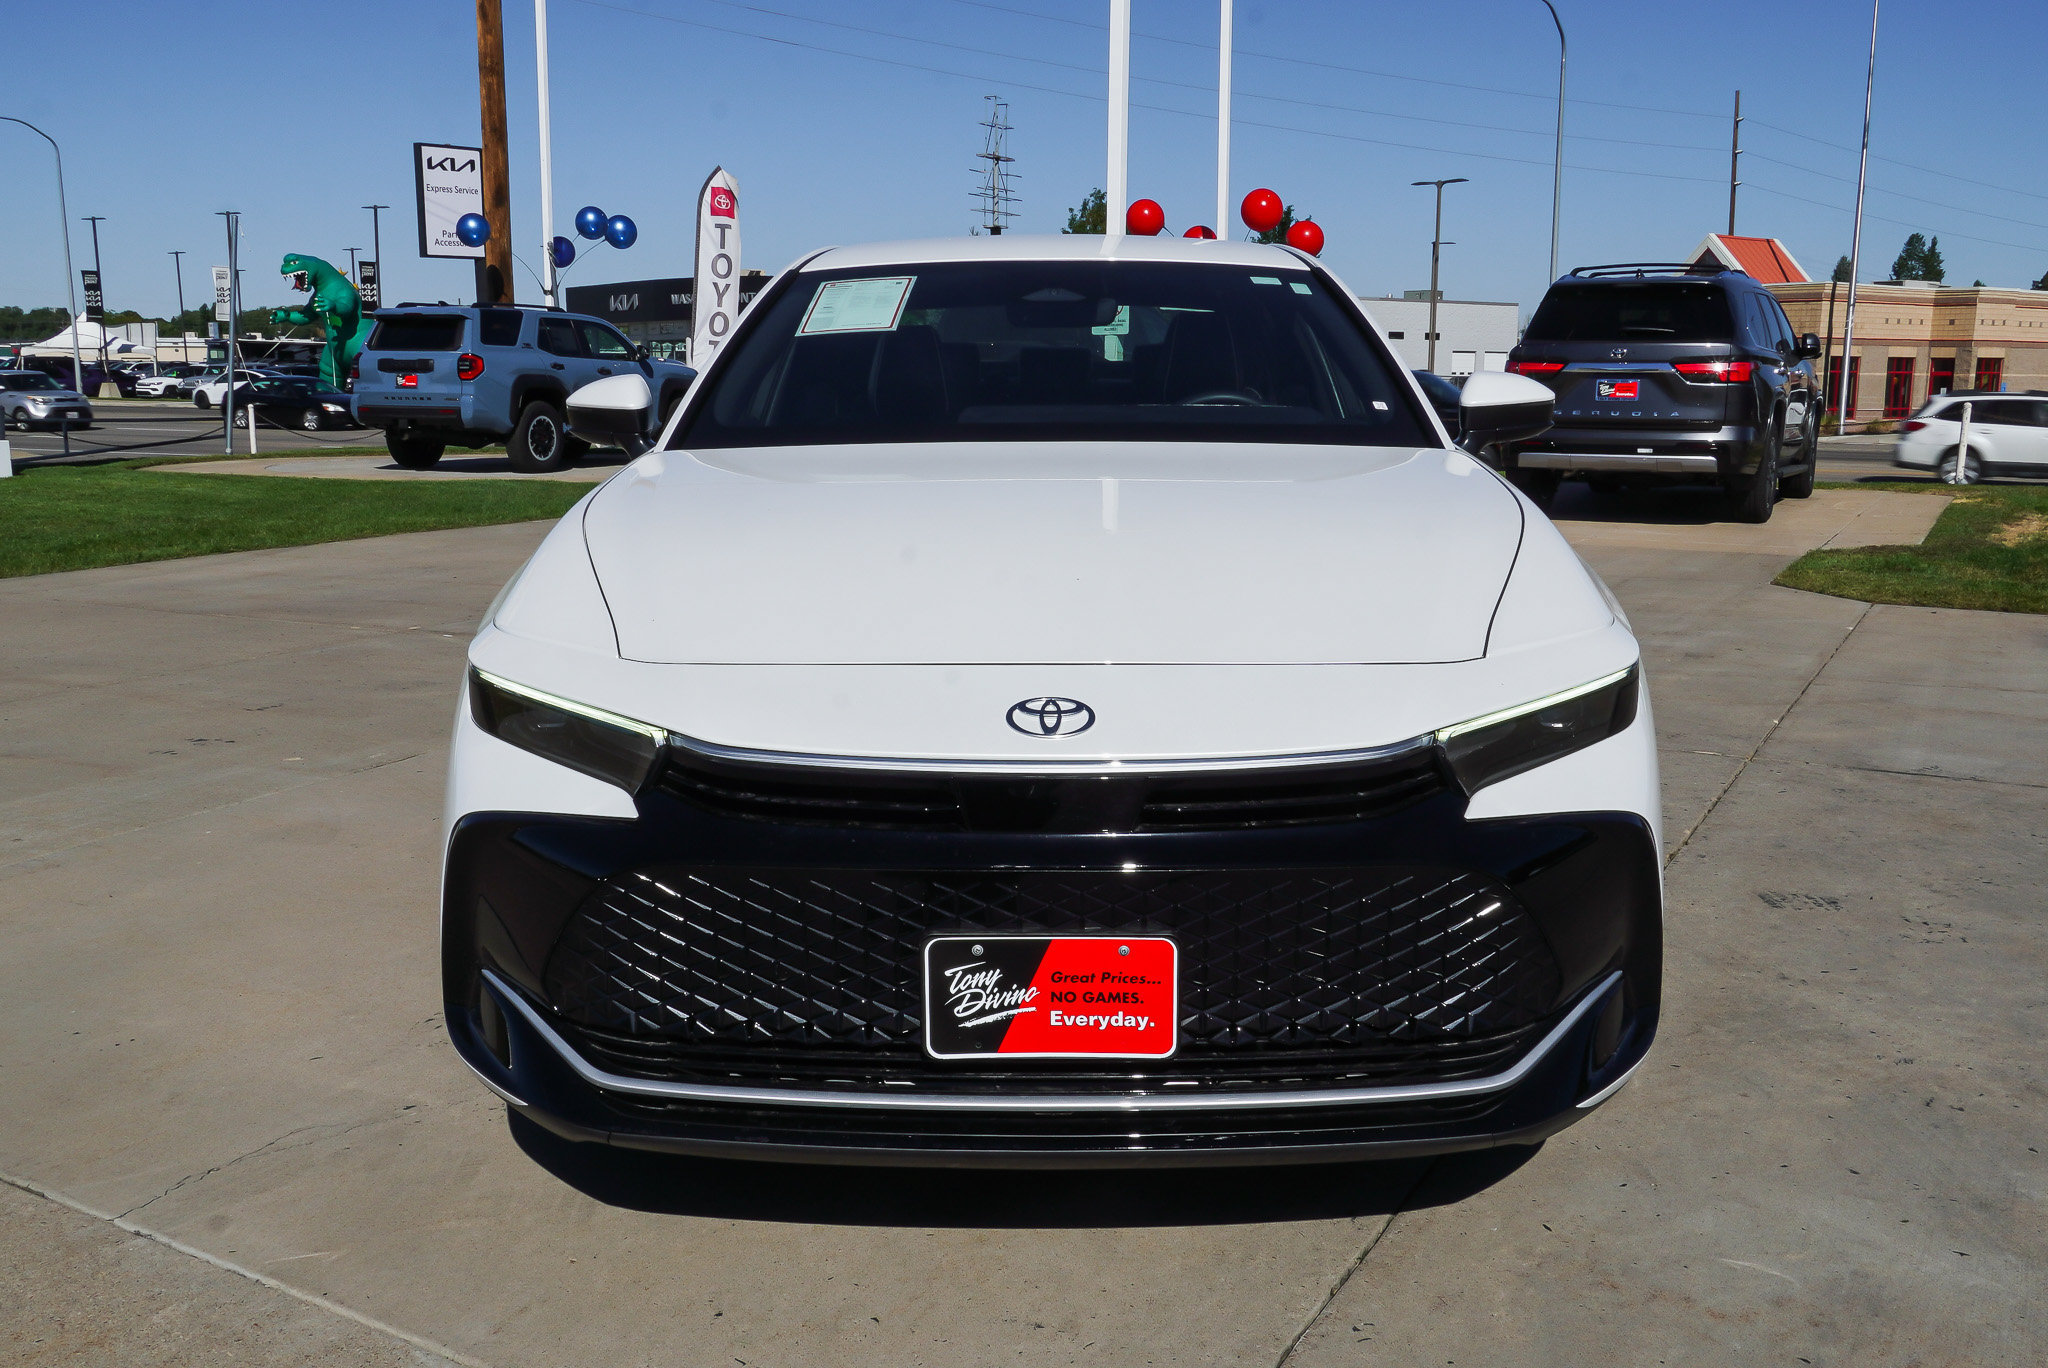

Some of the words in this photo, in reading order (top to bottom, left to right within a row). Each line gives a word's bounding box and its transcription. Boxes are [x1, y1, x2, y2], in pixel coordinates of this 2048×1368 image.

[427, 156, 476, 173] KIA
[426, 183, 453, 194] Express
[454, 186, 479, 195] Service
[442, 230, 458, 238] Par
[434, 238, 467, 247] Accesso
[609, 293, 639, 312] KIA
[671, 293, 693, 305] WAS
[944, 961, 1003, 995] Tony
[1050, 971, 1096, 984] Great
[1100, 971, 1162, 985] Prices...
[944, 984, 1041, 1018] Divino
[1050, 991, 1077, 1003] NO
[1082, 991, 1144, 1004] GAMES.
[1050, 1010, 1156, 1031] Everyday.
